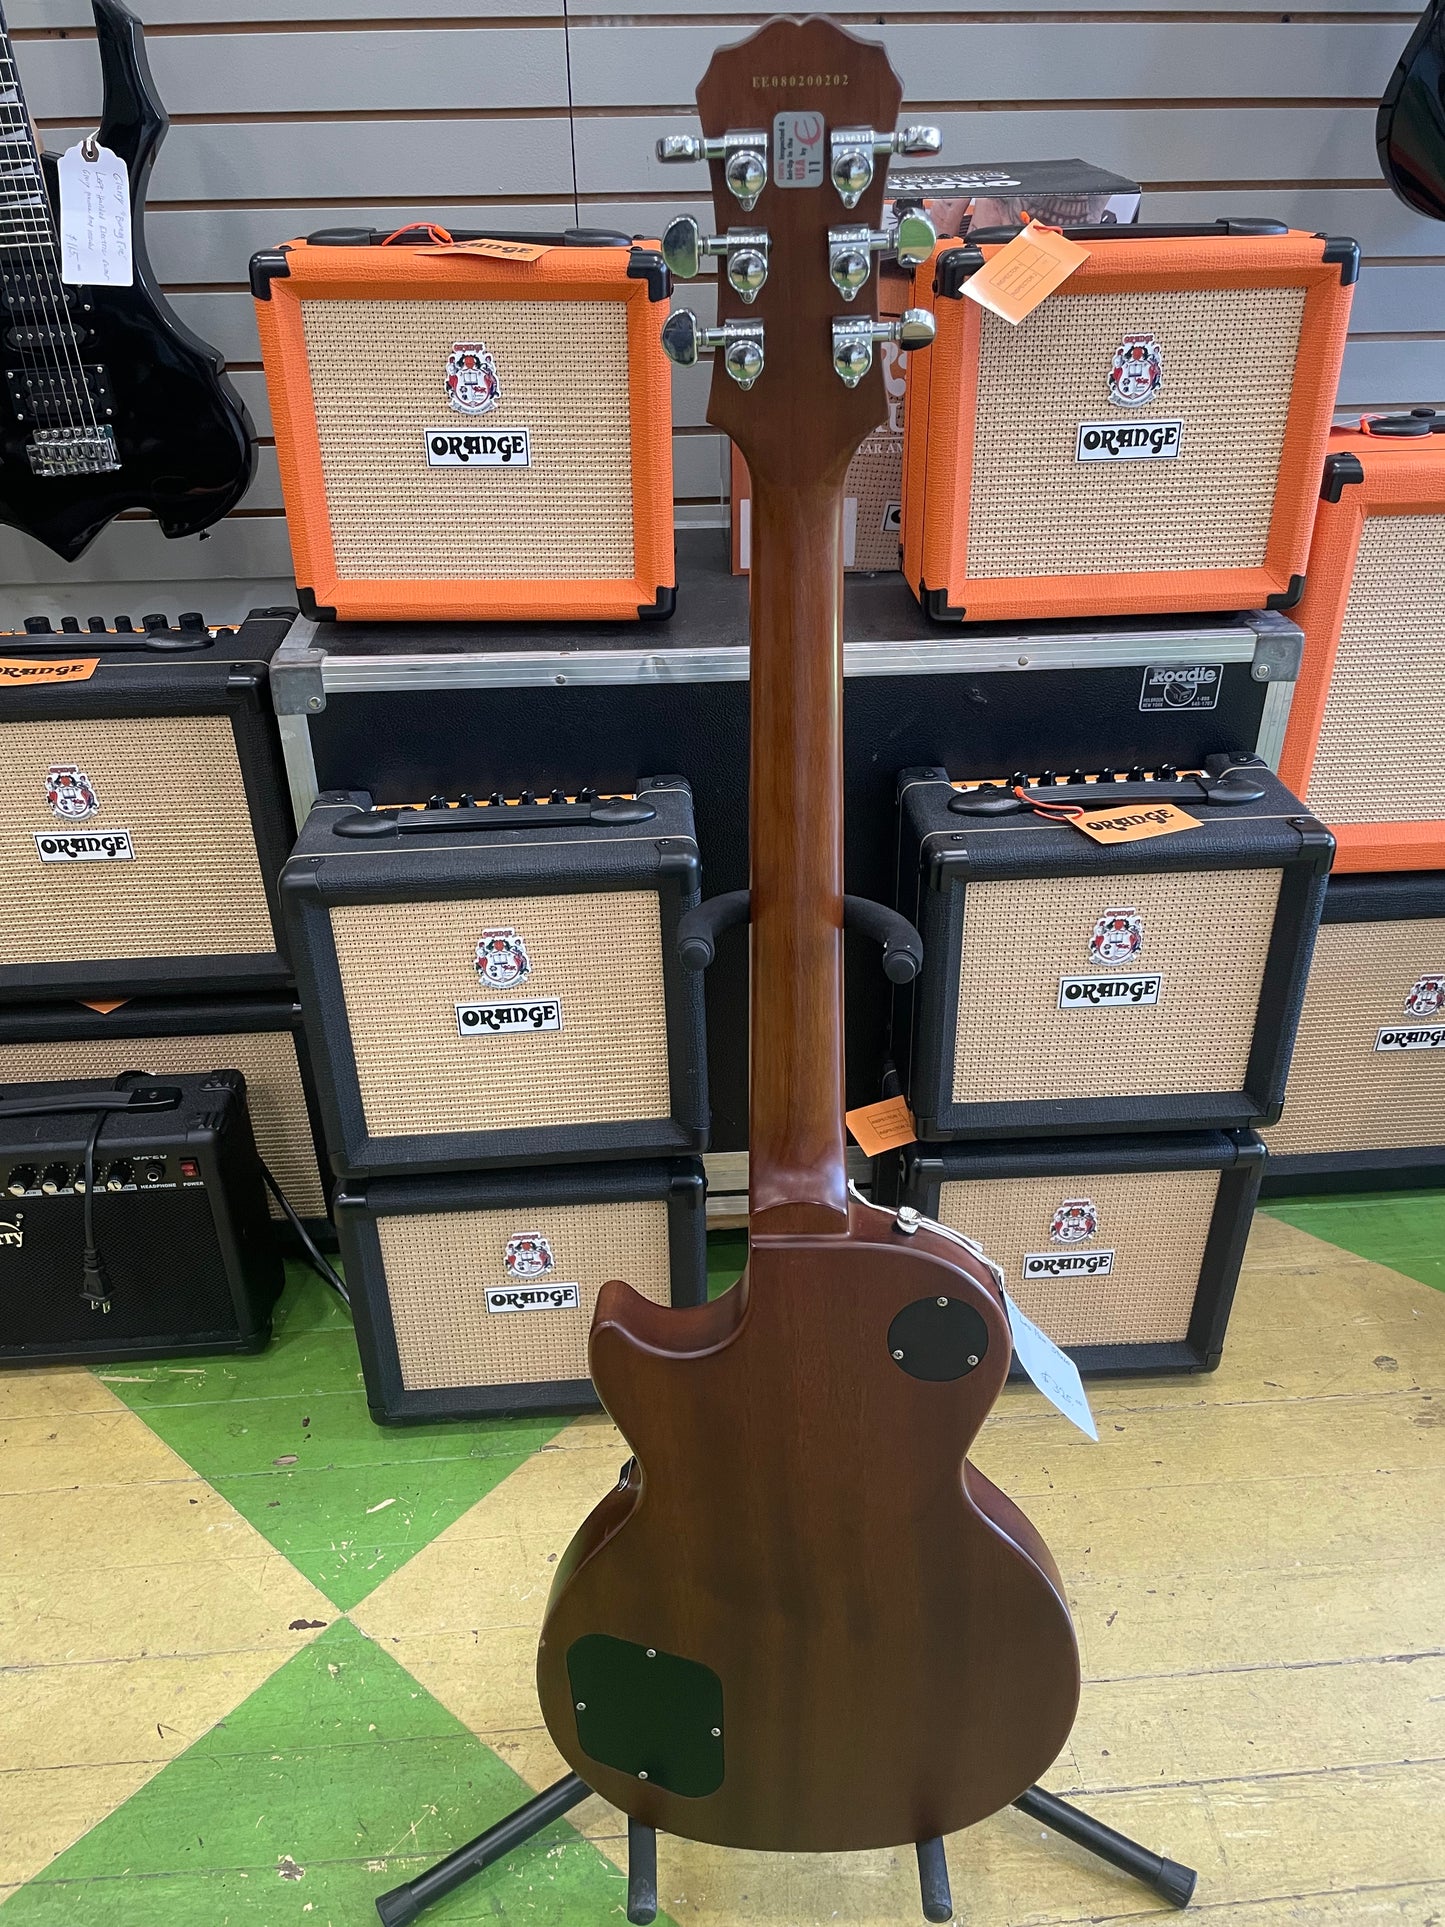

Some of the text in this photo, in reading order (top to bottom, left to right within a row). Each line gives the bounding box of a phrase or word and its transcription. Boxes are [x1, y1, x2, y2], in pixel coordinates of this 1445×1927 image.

[752, 74, 849, 88] EE080200202
[795, 159, 806, 180] USA
[808, 161, 820, 174] 11
[431, 436, 524, 462] ORANGE
[1083, 427, 1177, 456] ORANGE
[0, 664, 84, 678] RANGE
[1152, 667, 1216, 682] Roadie
[1085, 809, 1174, 831] ORANGE
[41, 836, 127, 858] ORANGE
[1065, 980, 1157, 1004] ORANGE
[462, 1005, 556, 1030] ORANGE
[1029, 1256, 1110, 1275] ORANGE
[490, 1289, 574, 1309] ORANGE
